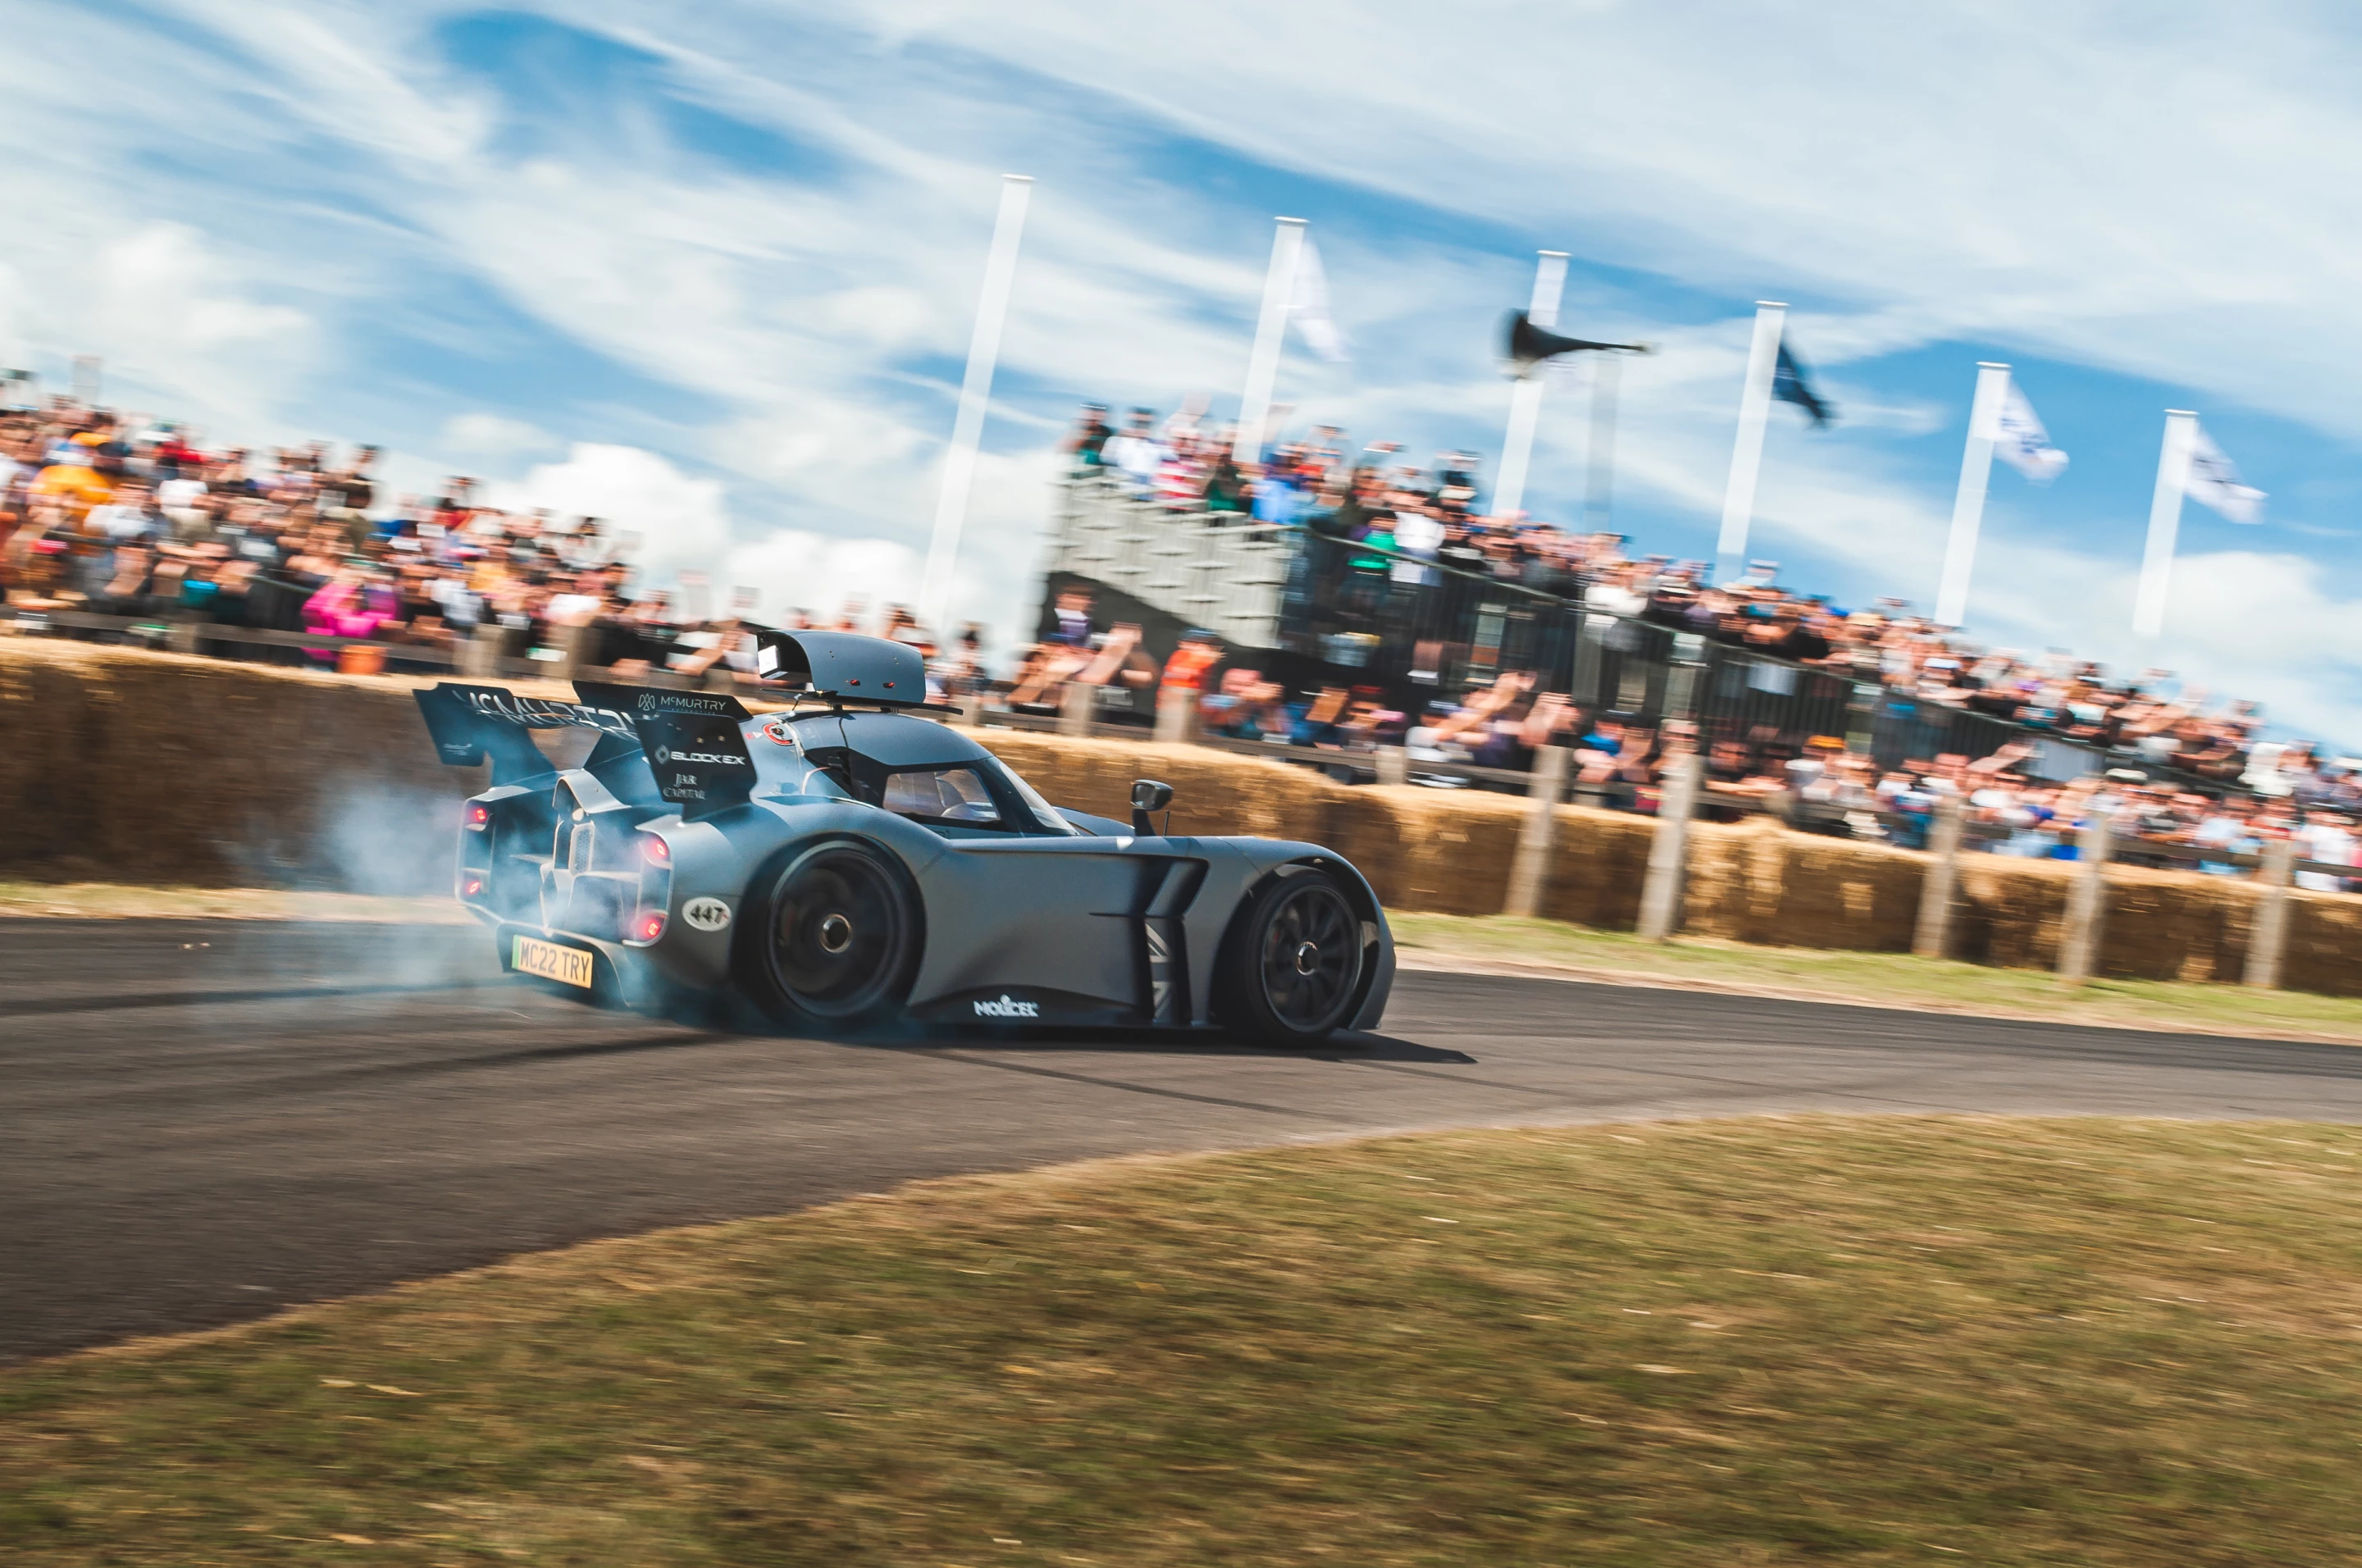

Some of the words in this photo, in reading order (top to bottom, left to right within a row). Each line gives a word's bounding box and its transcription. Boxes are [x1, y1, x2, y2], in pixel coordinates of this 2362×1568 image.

[670, 751, 746, 765] BLOCKEX
[673, 773, 698, 787] JAR
[663, 787, 707, 800] CAPITAL
[691, 905, 725, 924] 447
[520, 941, 558, 974] MC22
[562, 950, 590, 982] TRY
